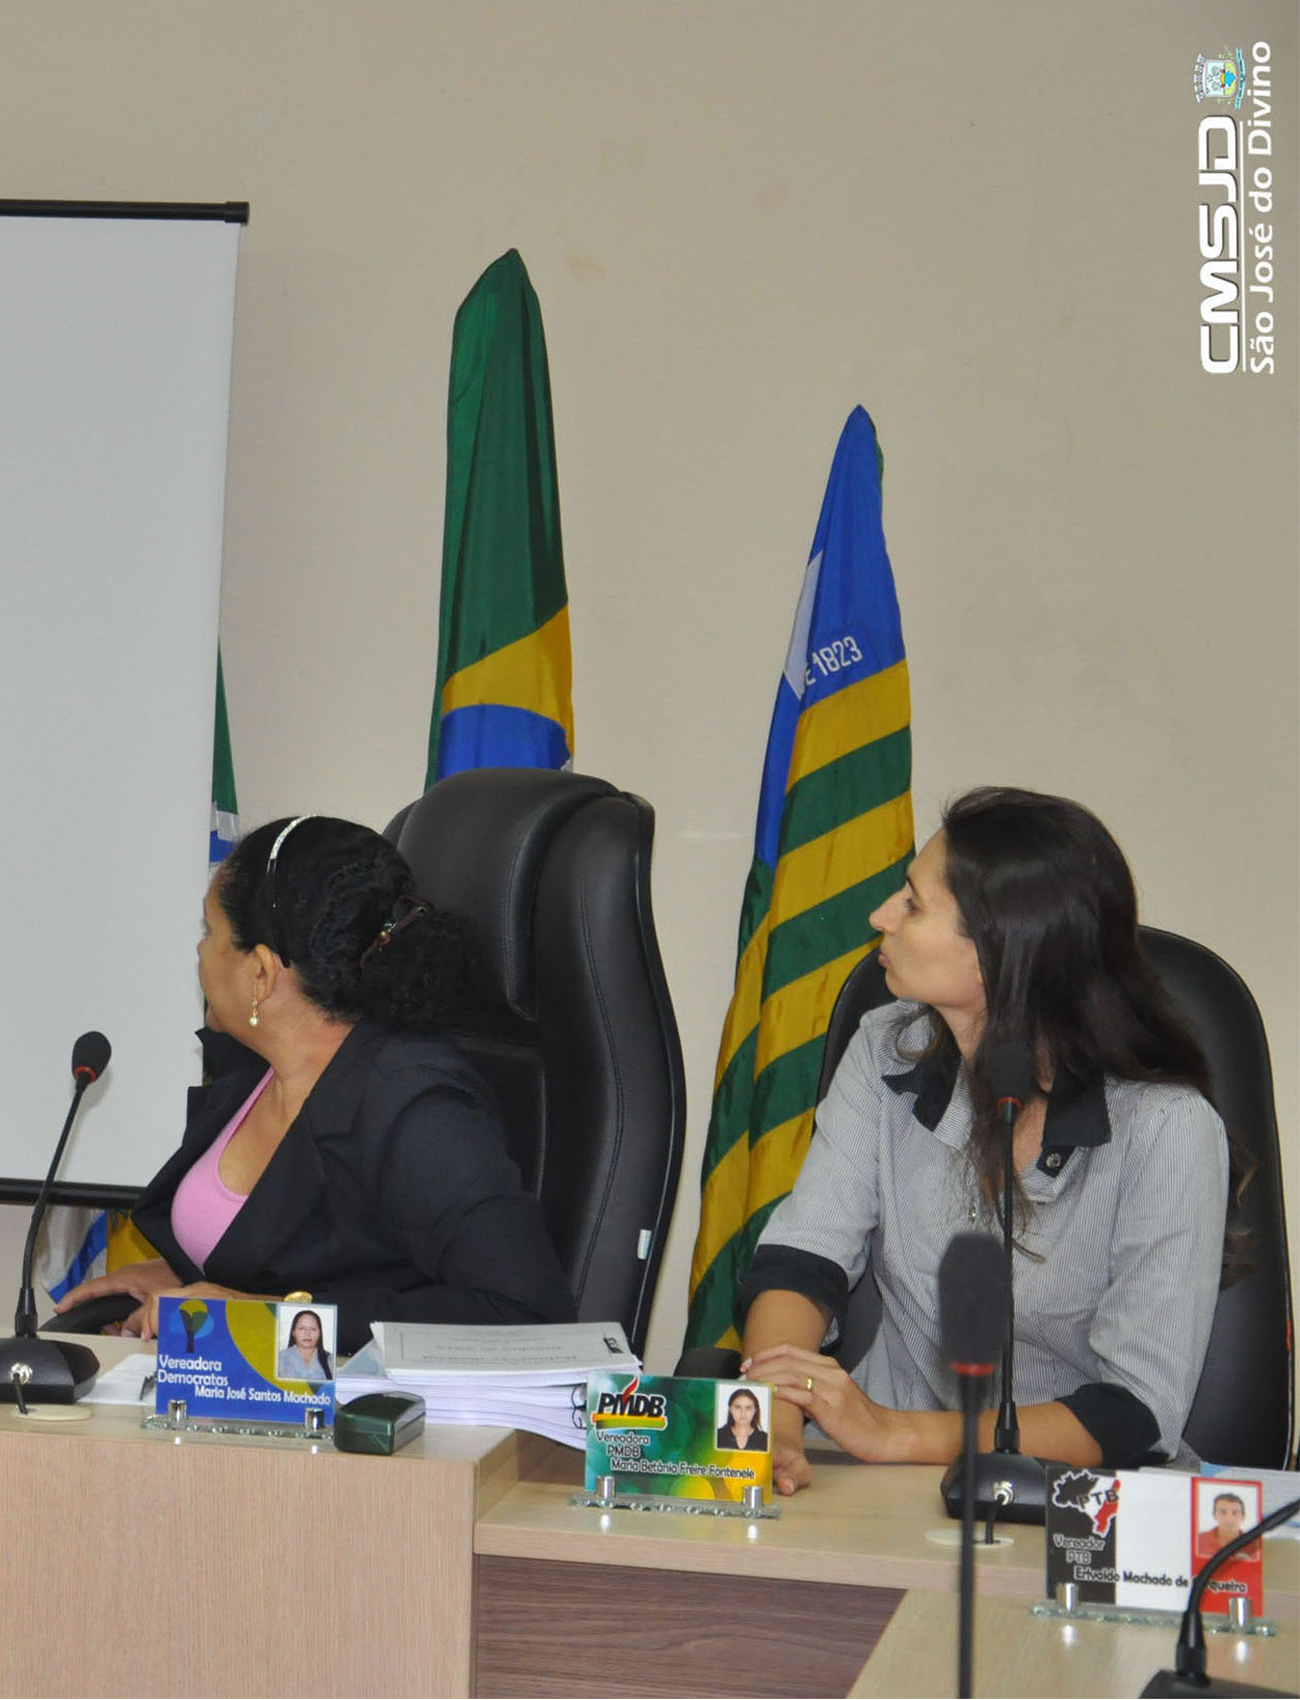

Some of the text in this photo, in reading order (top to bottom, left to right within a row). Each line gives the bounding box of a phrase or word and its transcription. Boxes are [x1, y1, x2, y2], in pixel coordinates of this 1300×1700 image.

[811, 636, 863, 676] 1823
[158, 1354, 223, 1372] Vereadora
[158, 1371, 229, 1387] Democratas
[195, 1385, 331, 1406] Maria José Santos Machado
[598, 1393, 666, 1417] PMDB
[596, 1431, 650, 1444] Vereadora
[606, 1445, 641, 1458] PMDB
[611, 1457, 756, 1480] Maria Betânia Freire Fontenele
[1077, 1489, 1119, 1510] PTB
[1053, 1534, 1105, 1551] Vereador
[1066, 1550, 1092, 1564] PTB
[1123, 1571, 1173, 1586] Machado
[1175, 1575, 1189, 1588] de
